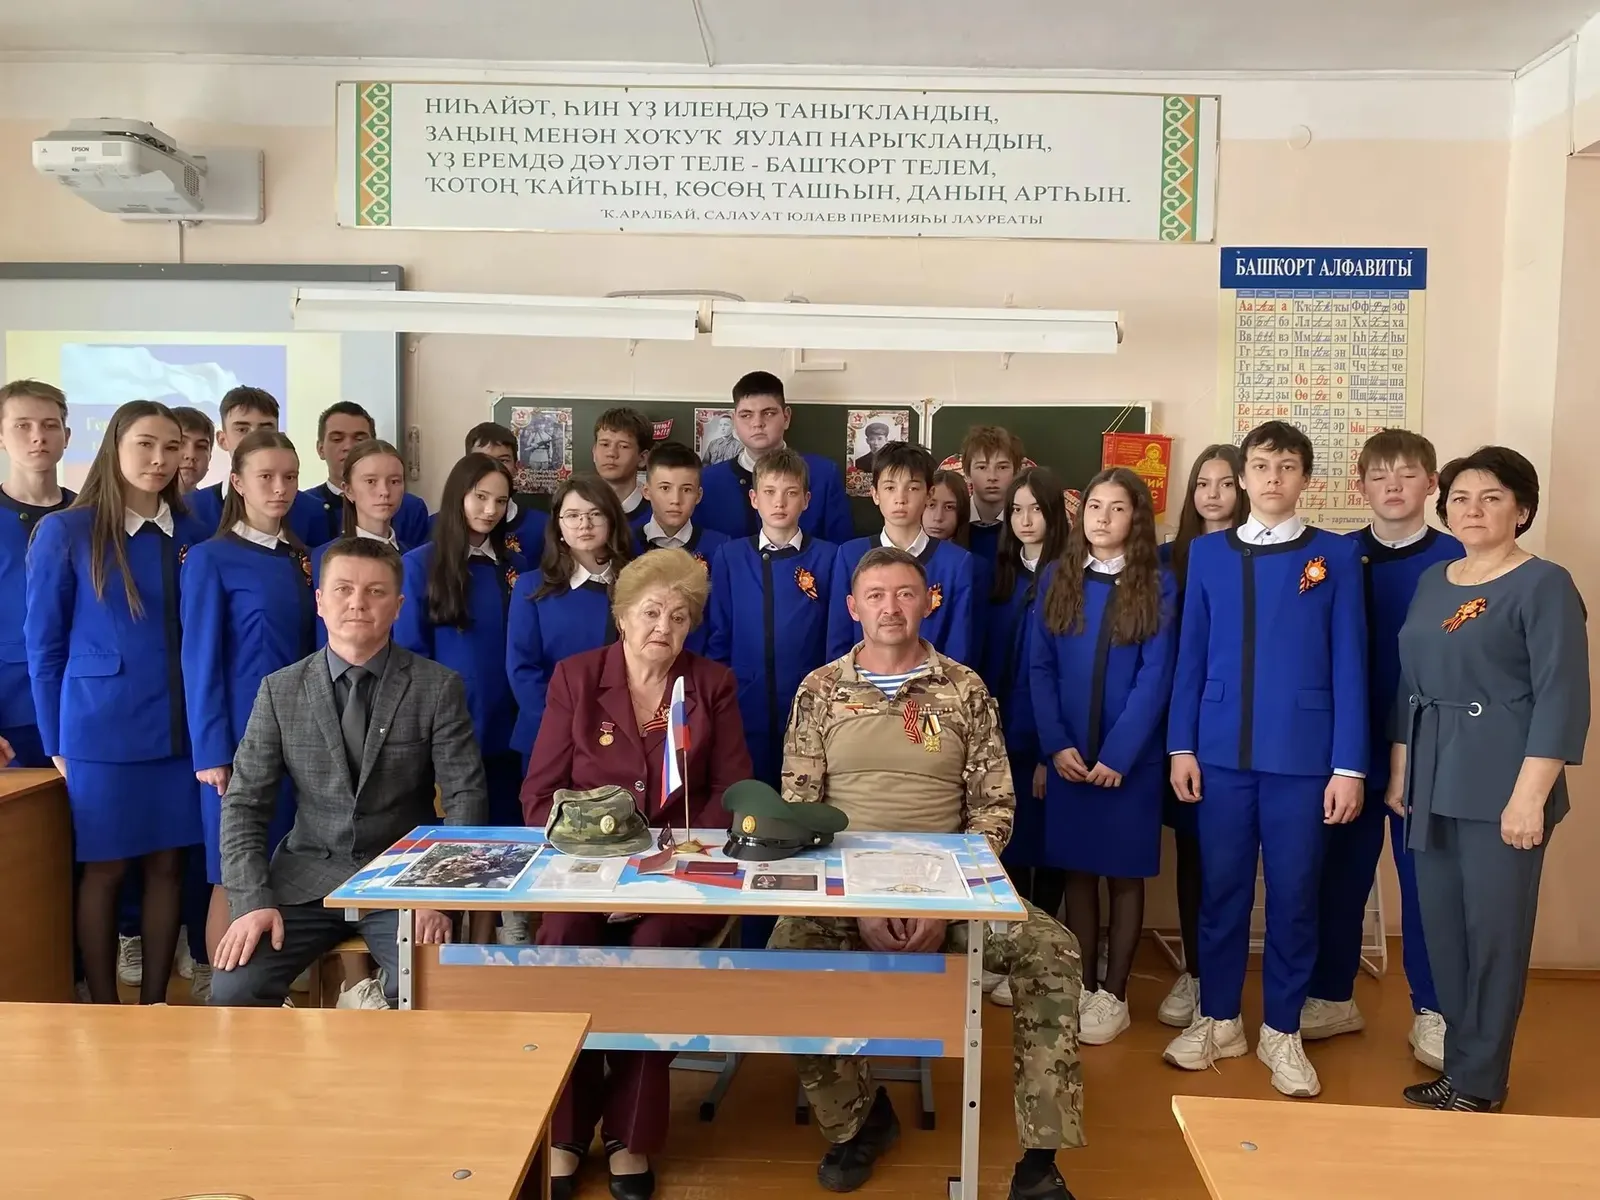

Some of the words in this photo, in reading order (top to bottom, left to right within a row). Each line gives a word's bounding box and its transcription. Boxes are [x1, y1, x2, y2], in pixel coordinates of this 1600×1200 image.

[564, 100, 620, 117] ҺИН
[664, 101, 769, 121] ИЛЕҢДӘ
[425, 125, 518, 145] ЗАҢЫҢ
[524, 126, 616, 144] МЕНӘН
[624, 128, 722, 145] ХОҠУҠ
[732, 129, 823, 147] ЯУЛАП
[462, 152, 565, 172] ЕРЕМДӘ
[570, 154, 676, 174] ДӘҮЛӘТ
[681, 155, 746, 172] ТЕЛЕ
[766, 156, 897, 175] БАШҠОРТ
[902, 158, 997, 178] ТЕЛЕМ,
[425, 176, 519, 196] ҠОТОҢ
[675, 180, 766, 201] КӨСӨҢ
[907, 184, 1008, 204] ДАНЫҢ
[704, 210, 784, 221] САЛАУАТ
[787, 211, 847, 222] ЮЛАЕВ
[952, 214, 1044, 225] ЛАУРЕАТЫ
[1318, 258, 1414, 277] АЛФАВИТЫ
